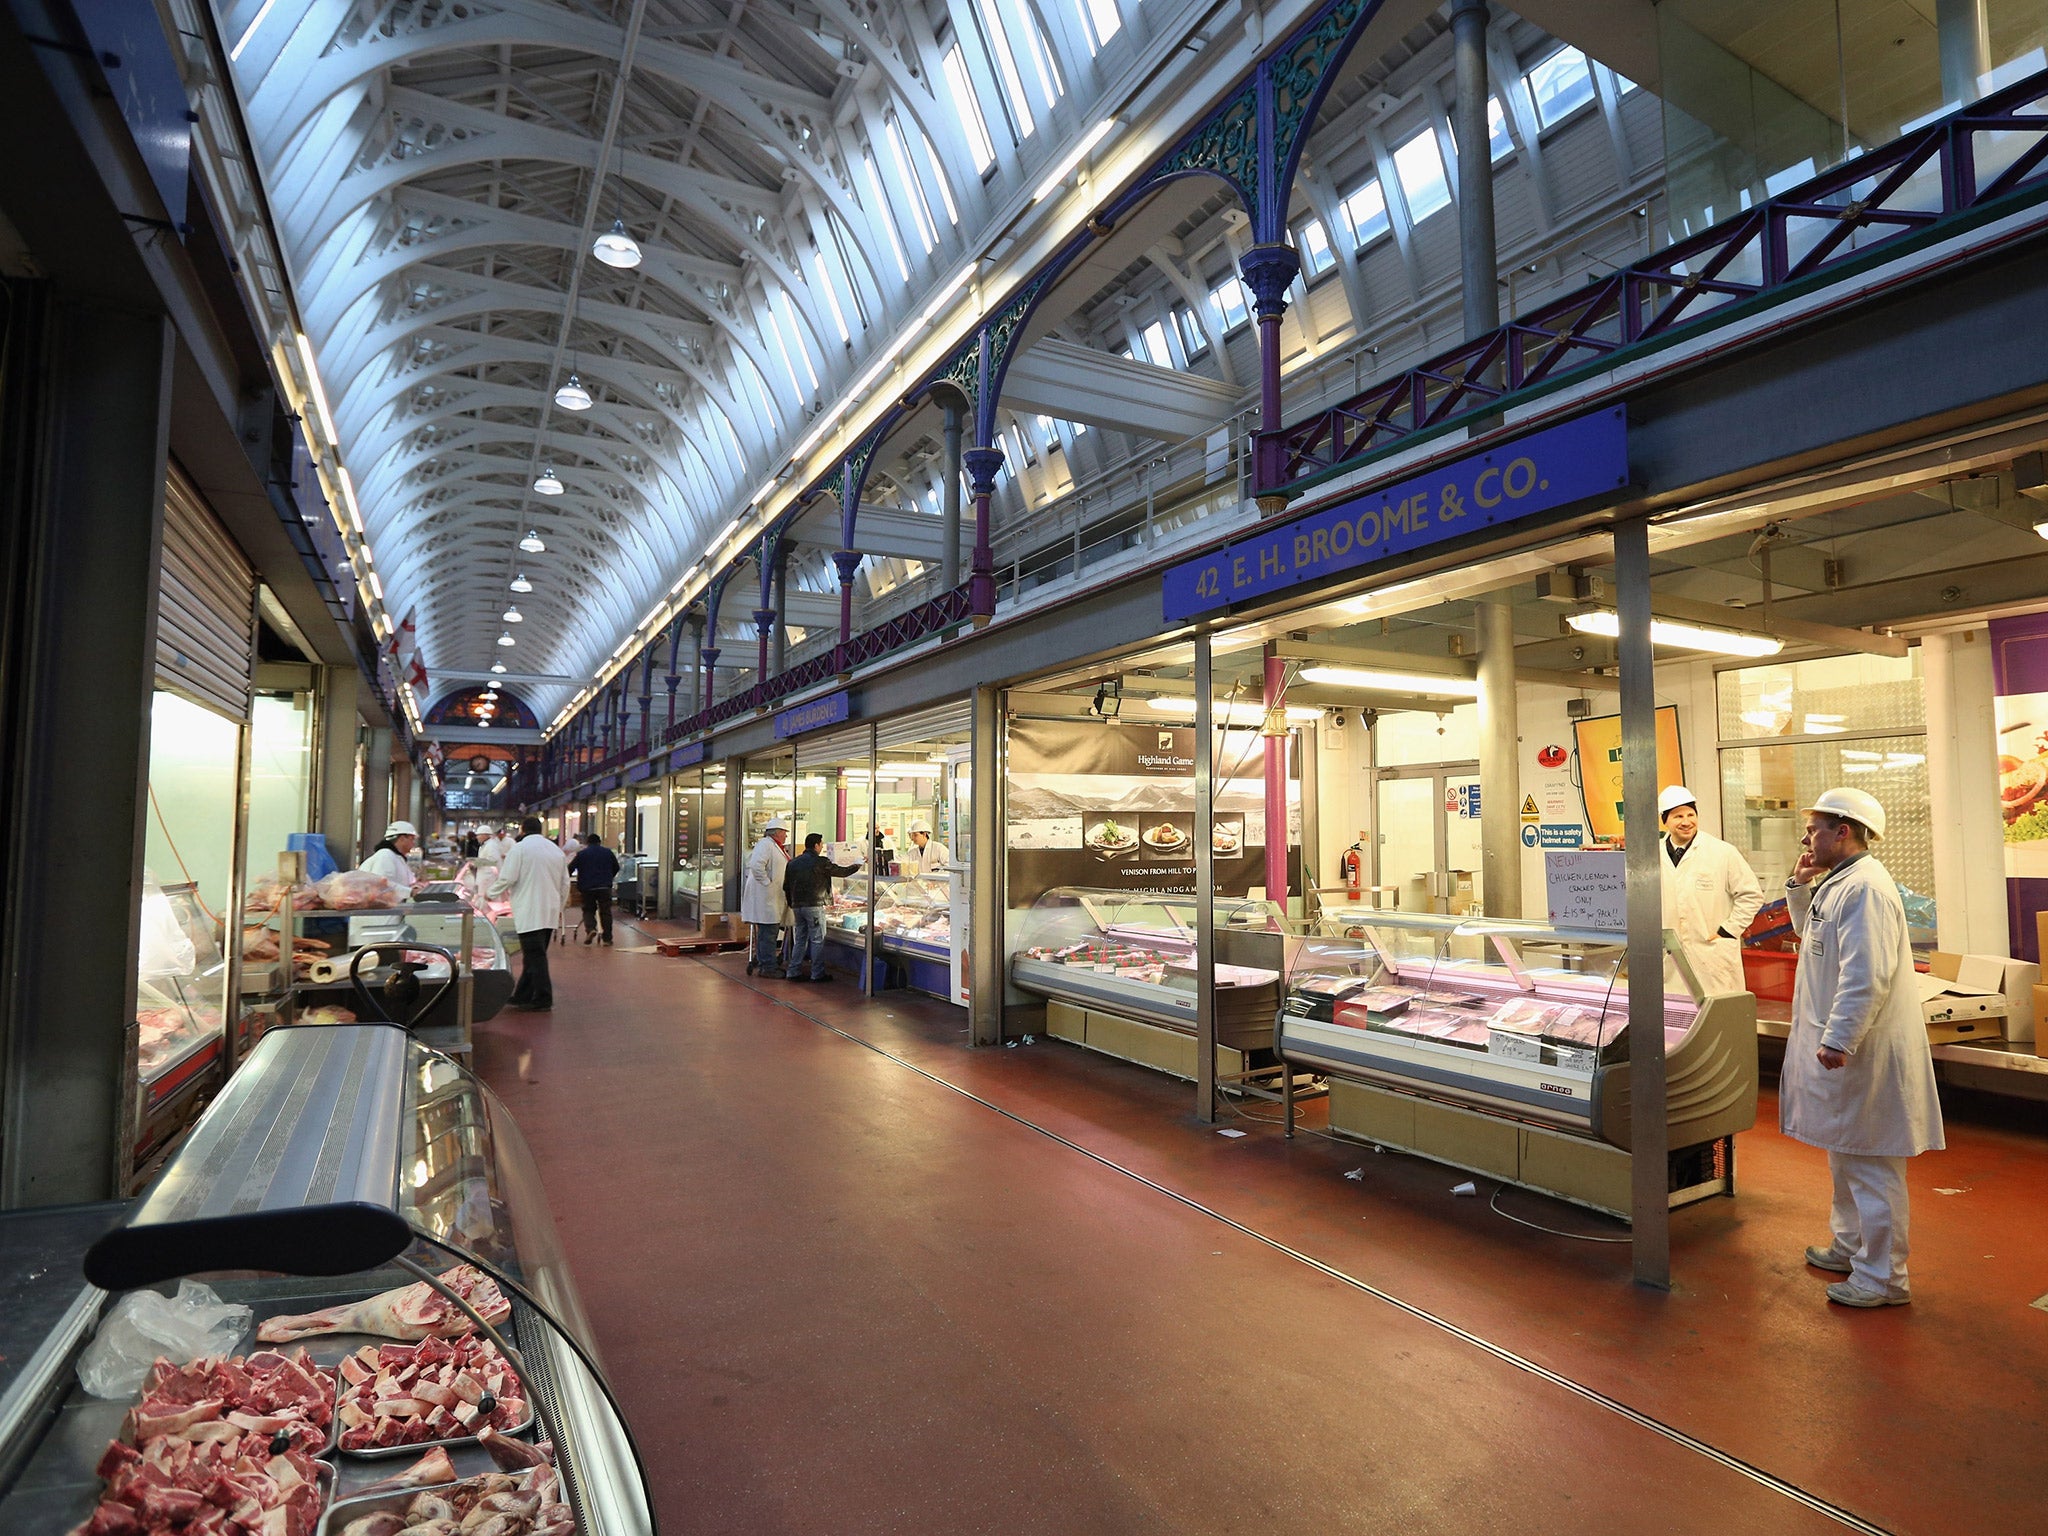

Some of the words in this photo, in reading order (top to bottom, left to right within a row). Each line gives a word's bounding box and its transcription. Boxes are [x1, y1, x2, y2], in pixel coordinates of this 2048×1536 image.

[1195, 566, 1220, 599] 42
[1233, 556, 1253, 589] E.
[1259, 544, 1286, 580] H.
[1294, 491, 1429, 569] BROOME
[1438, 483, 1467, 522] &
[1474, 457, 1550, 509] CO.
[1137, 755, 1172, 766] Highland
[1172, 757, 1194, 766] Game
[1564, 829, 1582, 837] safety
[1121, 868, 1149, 876] VENISON
[1149, 867, 1167, 875] FROM
[1168, 867, 1181, 875] HILL
